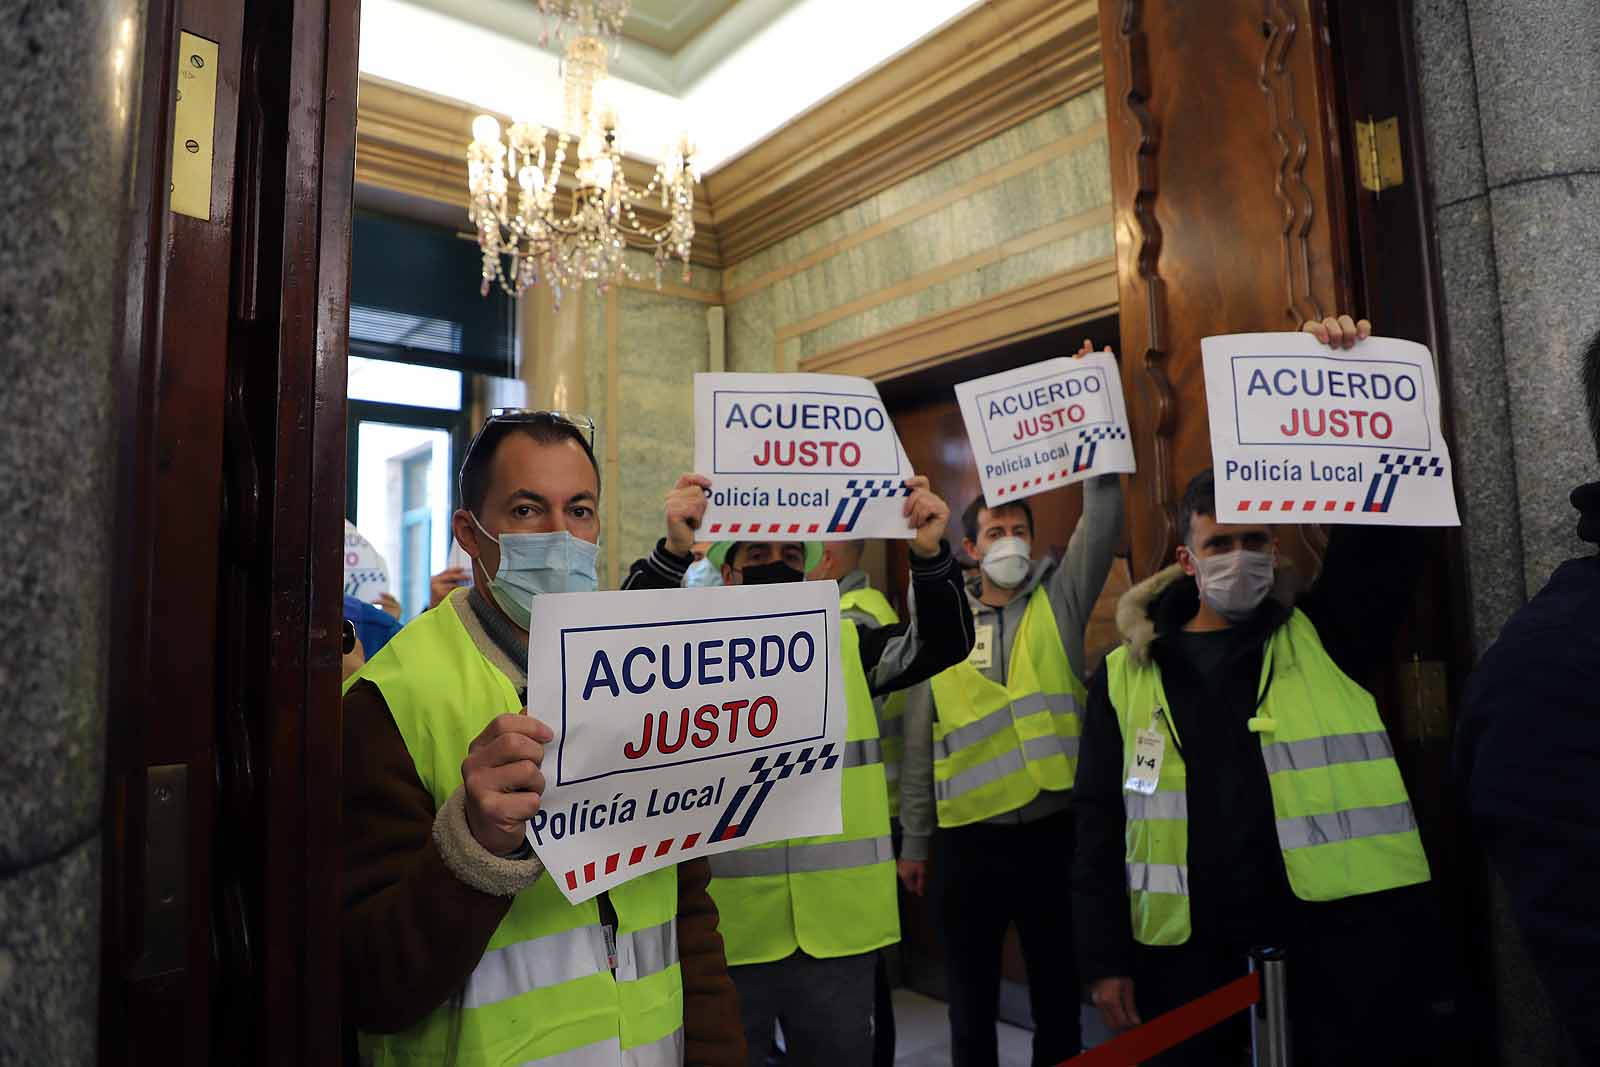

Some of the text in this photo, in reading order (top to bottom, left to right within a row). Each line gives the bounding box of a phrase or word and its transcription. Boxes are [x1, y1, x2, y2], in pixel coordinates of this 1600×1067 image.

[988, 375, 1101, 420] ACUERDO
[1247, 368, 1416, 402] ACUERDO
[725, 403, 885, 432] ACUERDO
[1013, 404, 1086, 440] JUSTO
[1280, 408, 1393, 440] JUSTO
[753, 440, 862, 468] JUSTO
[1034, 442, 1070, 465] Local
[1226, 459, 1363, 483] Policía Local
[777, 487, 829, 508] Local
[582, 631, 815, 700] ACUERDO
[623, 695, 778, 760] JUSTO
[1136, 754, 1156, 769] V-4
[530, 777, 726, 846] Policía Local
